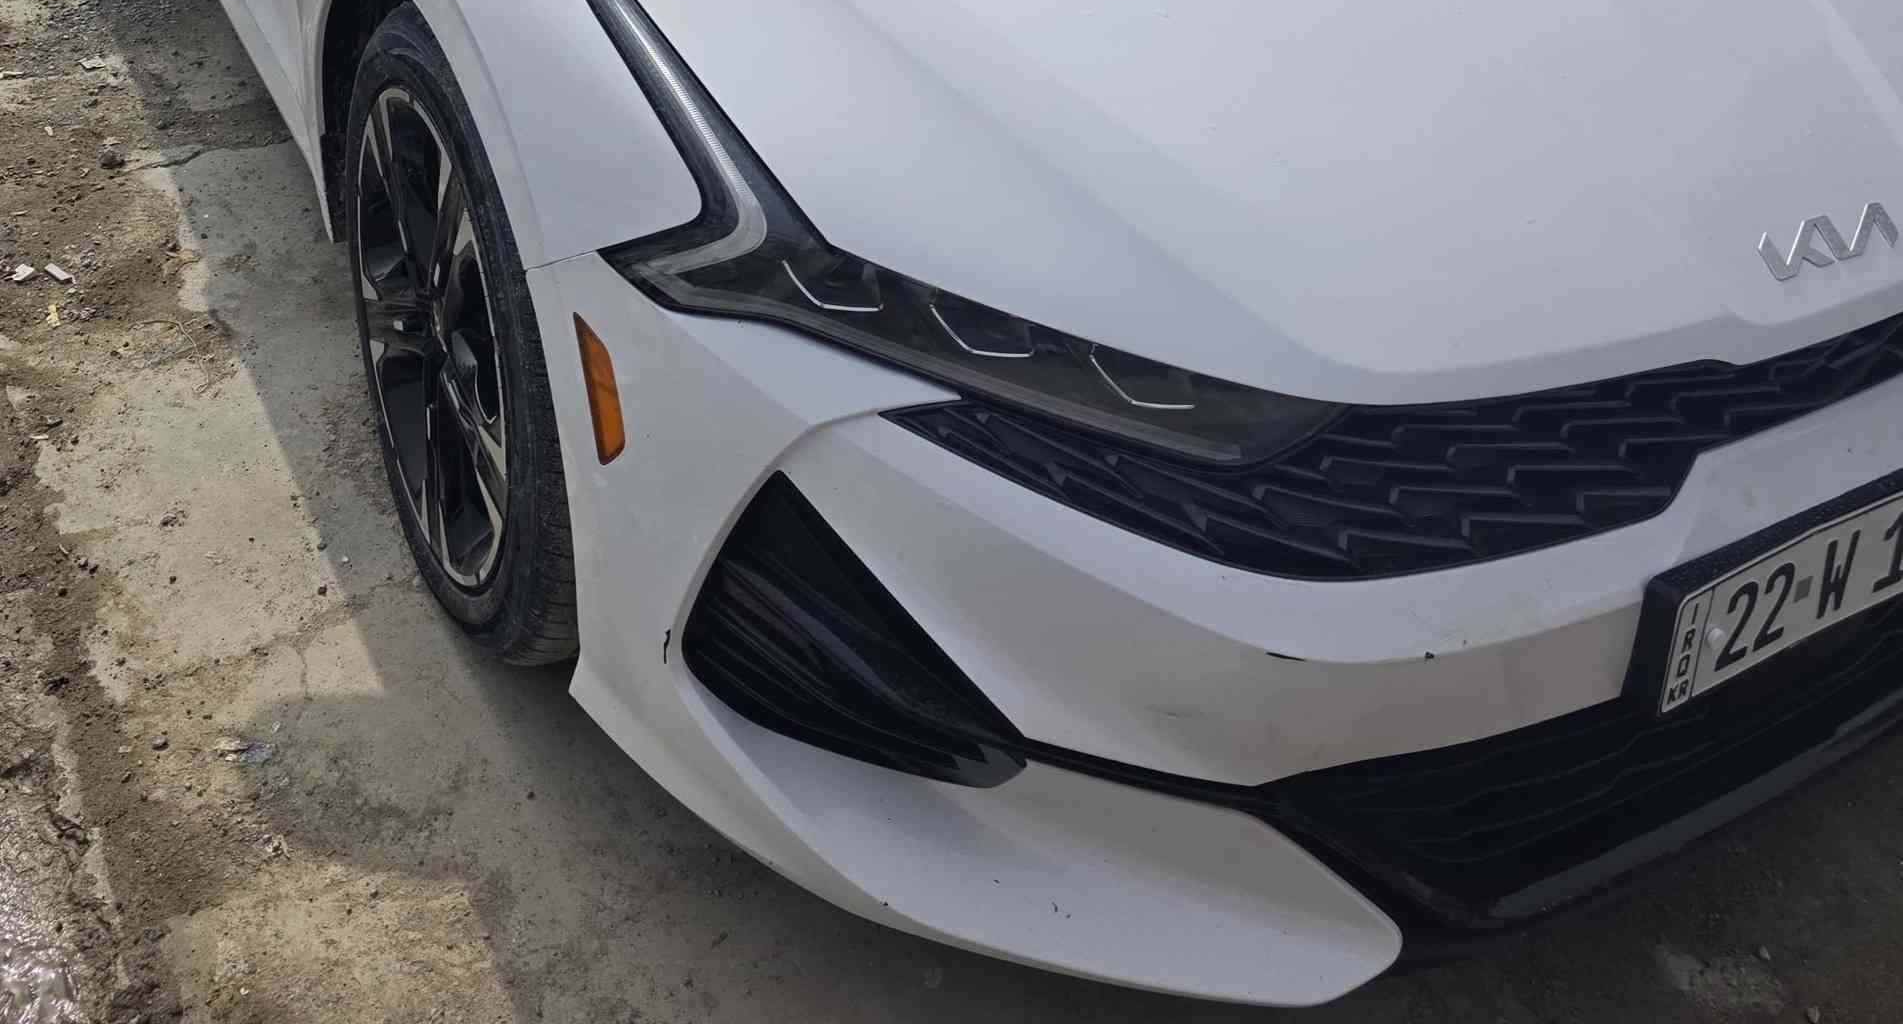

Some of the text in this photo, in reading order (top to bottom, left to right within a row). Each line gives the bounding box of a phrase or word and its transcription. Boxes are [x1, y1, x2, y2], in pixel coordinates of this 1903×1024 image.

[1757, 202, 1899, 281] KIA
[1714, 561, 1796, 672] 22
[1815, 529, 1861, 620] W
[1666, 680, 1689, 705] KR
